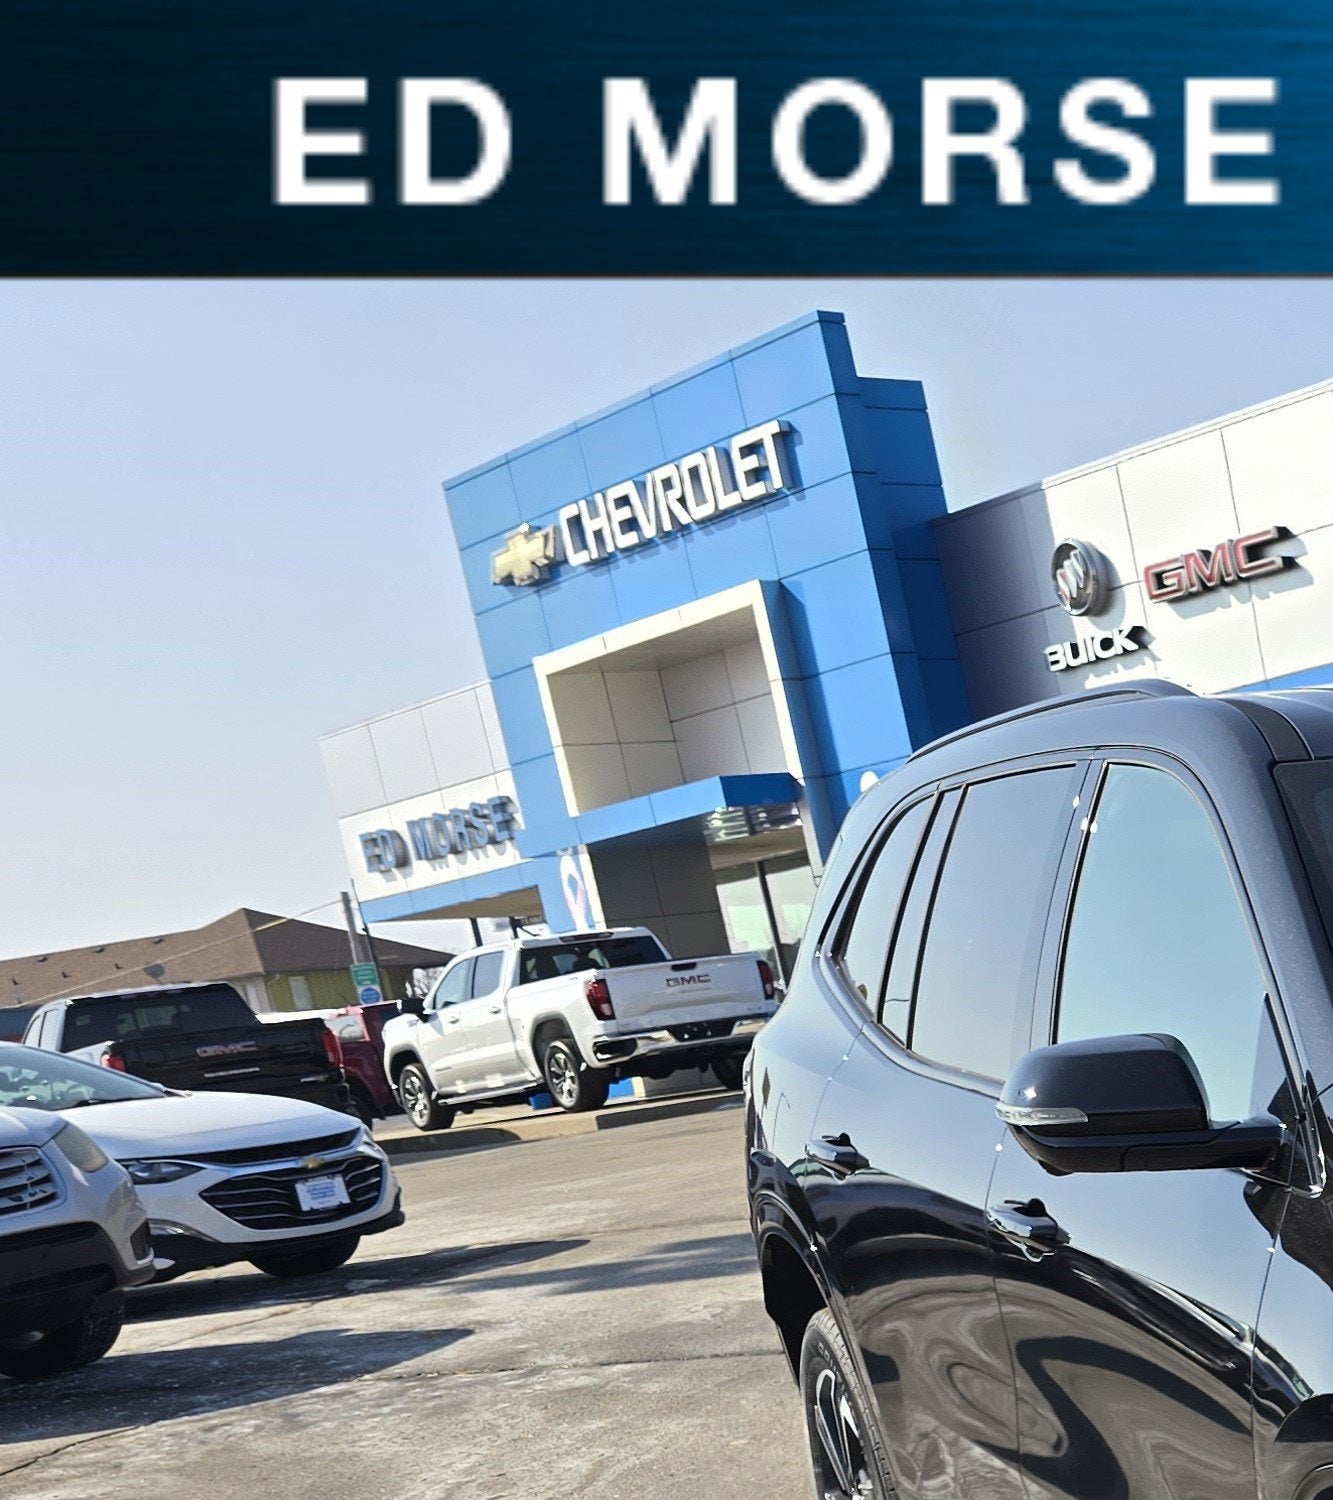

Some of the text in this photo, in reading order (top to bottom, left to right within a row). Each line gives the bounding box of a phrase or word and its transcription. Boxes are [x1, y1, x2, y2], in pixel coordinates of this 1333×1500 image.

[559, 419, 784, 567] CHEVROLET
[1144, 526, 1284, 603] GMC
[1044, 626, 1139, 672] BUICK
[359, 796, 514, 873] ED MORSE
